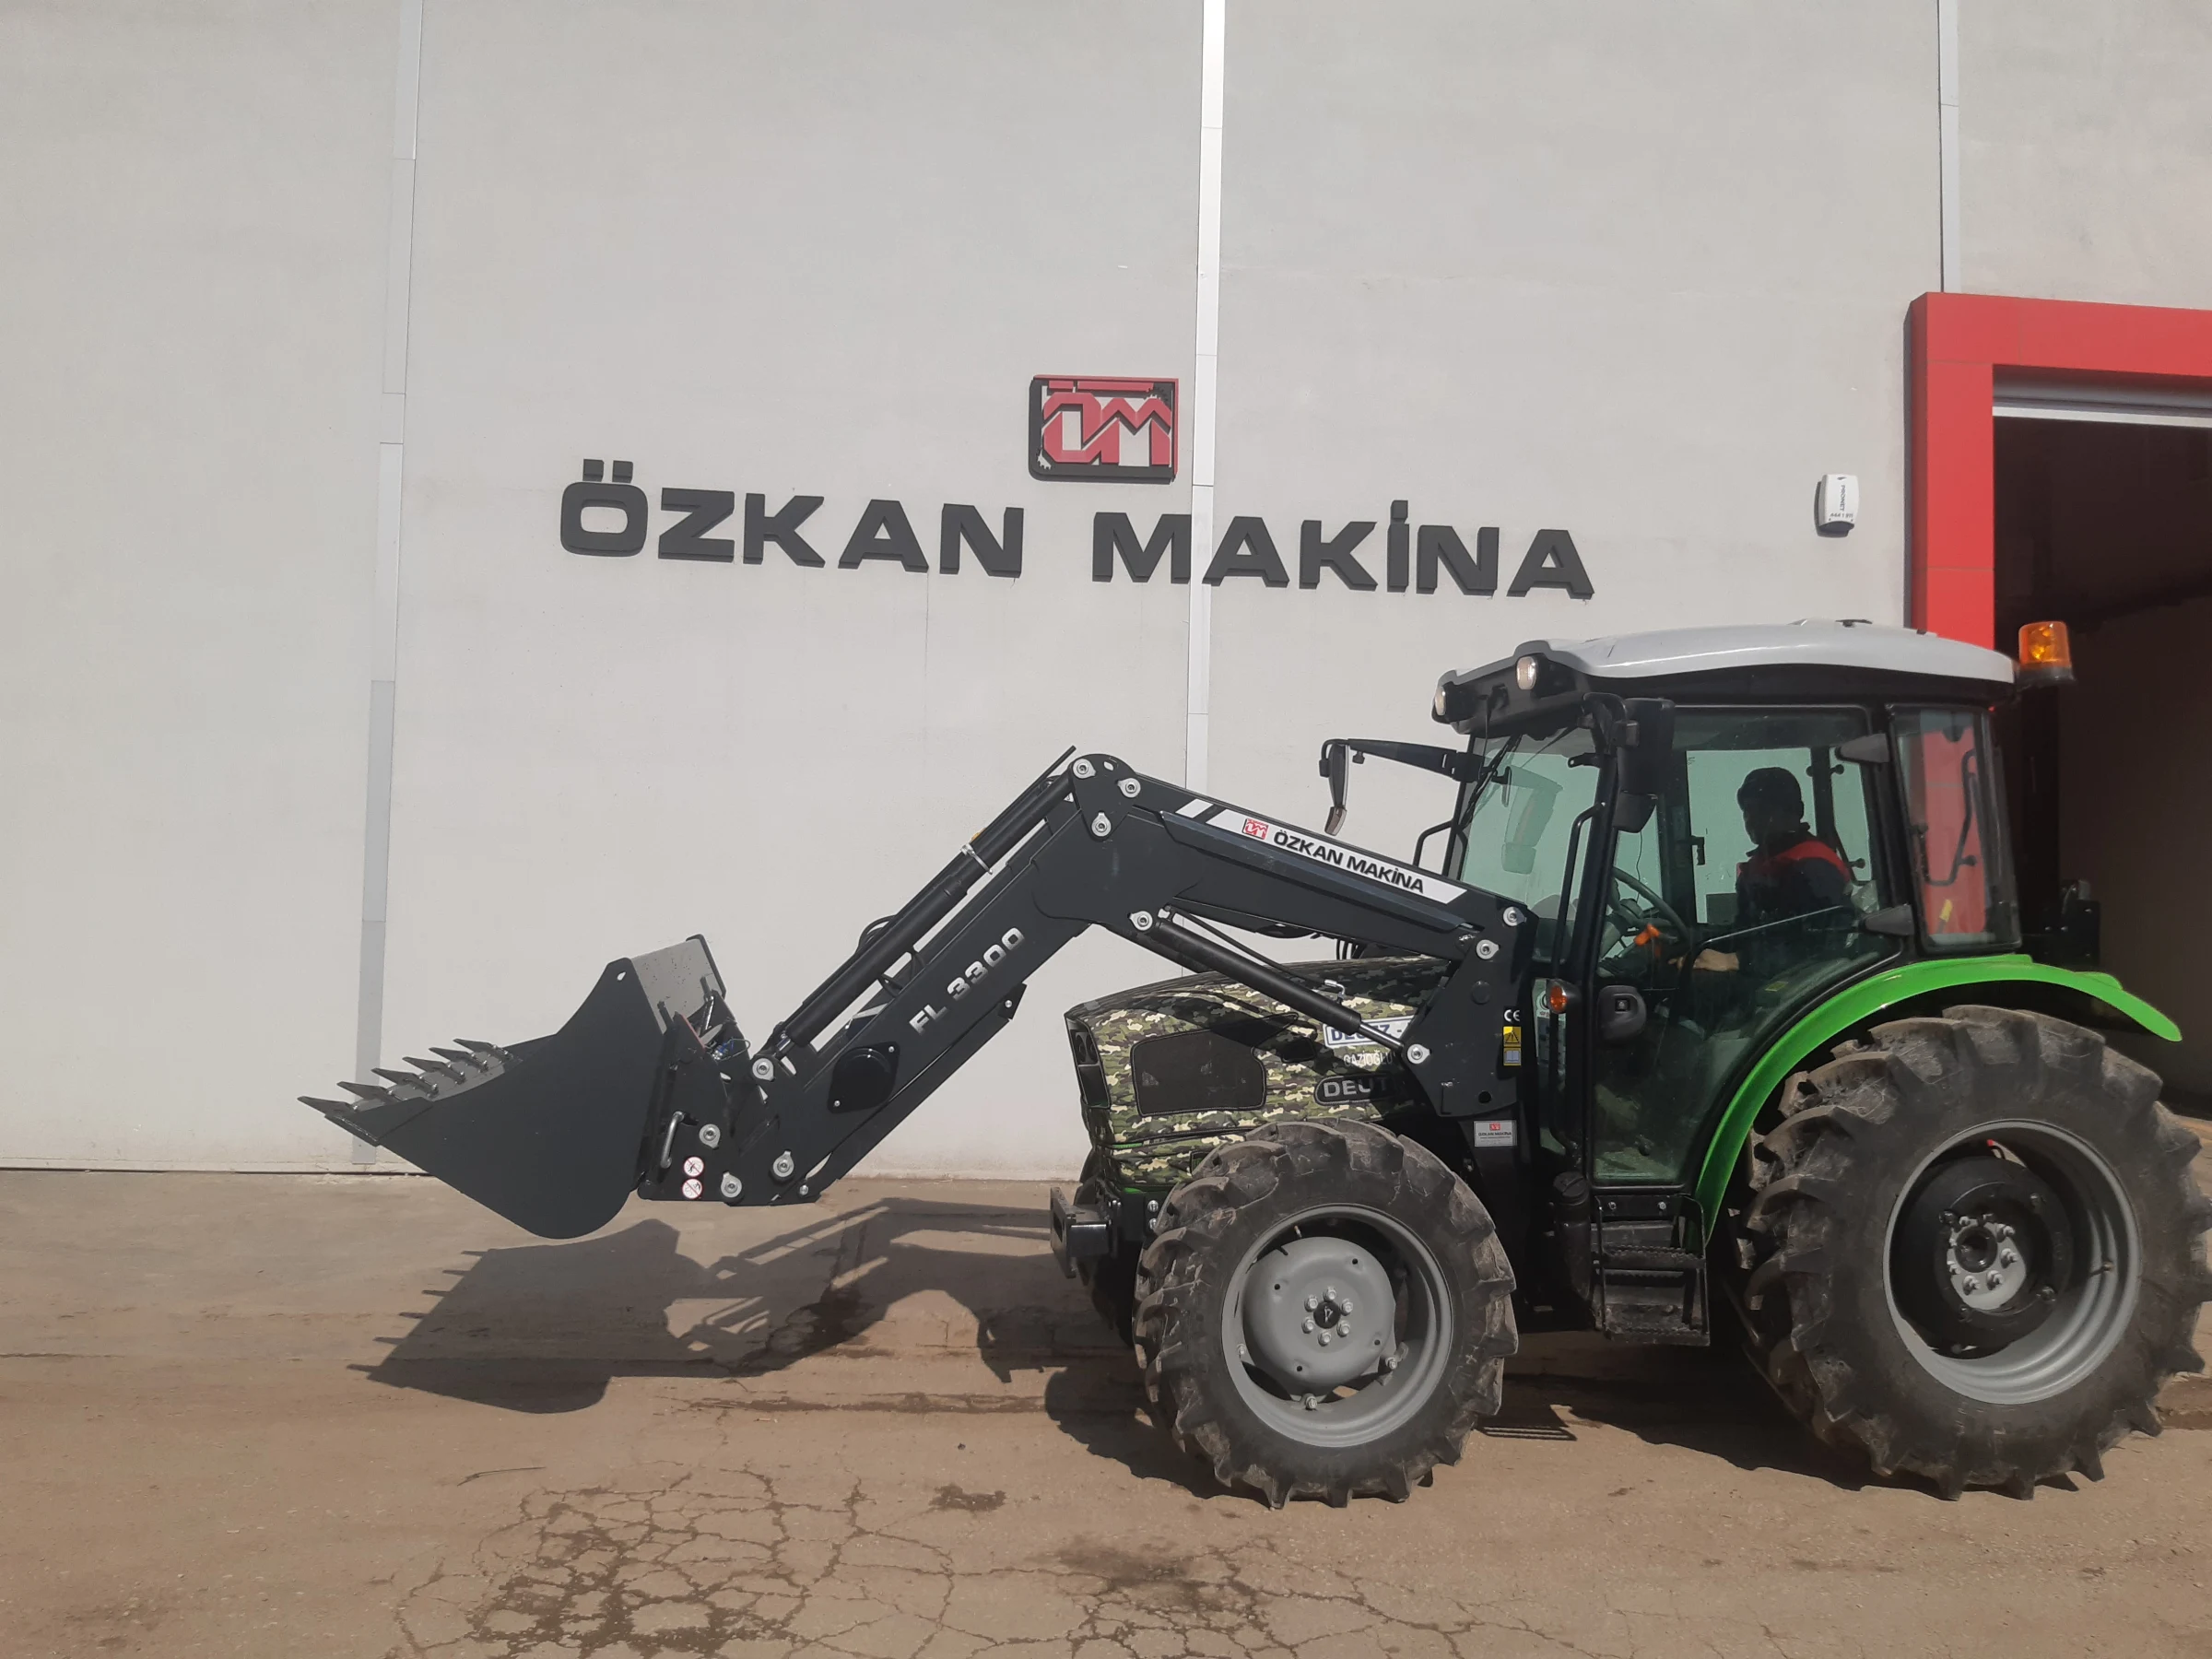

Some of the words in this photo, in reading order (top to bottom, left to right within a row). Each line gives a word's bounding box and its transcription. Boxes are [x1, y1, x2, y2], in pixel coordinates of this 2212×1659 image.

[559, 458, 1025, 579] ÖZKAN
[1092, 500, 1595, 600] MAKİNA
[1273, 829, 1348, 866] ÖZKAN
[1346, 855, 1424, 894] MAKİNA
[909, 1004, 947, 1035] FL
[947, 927, 1025, 1001] 3300
